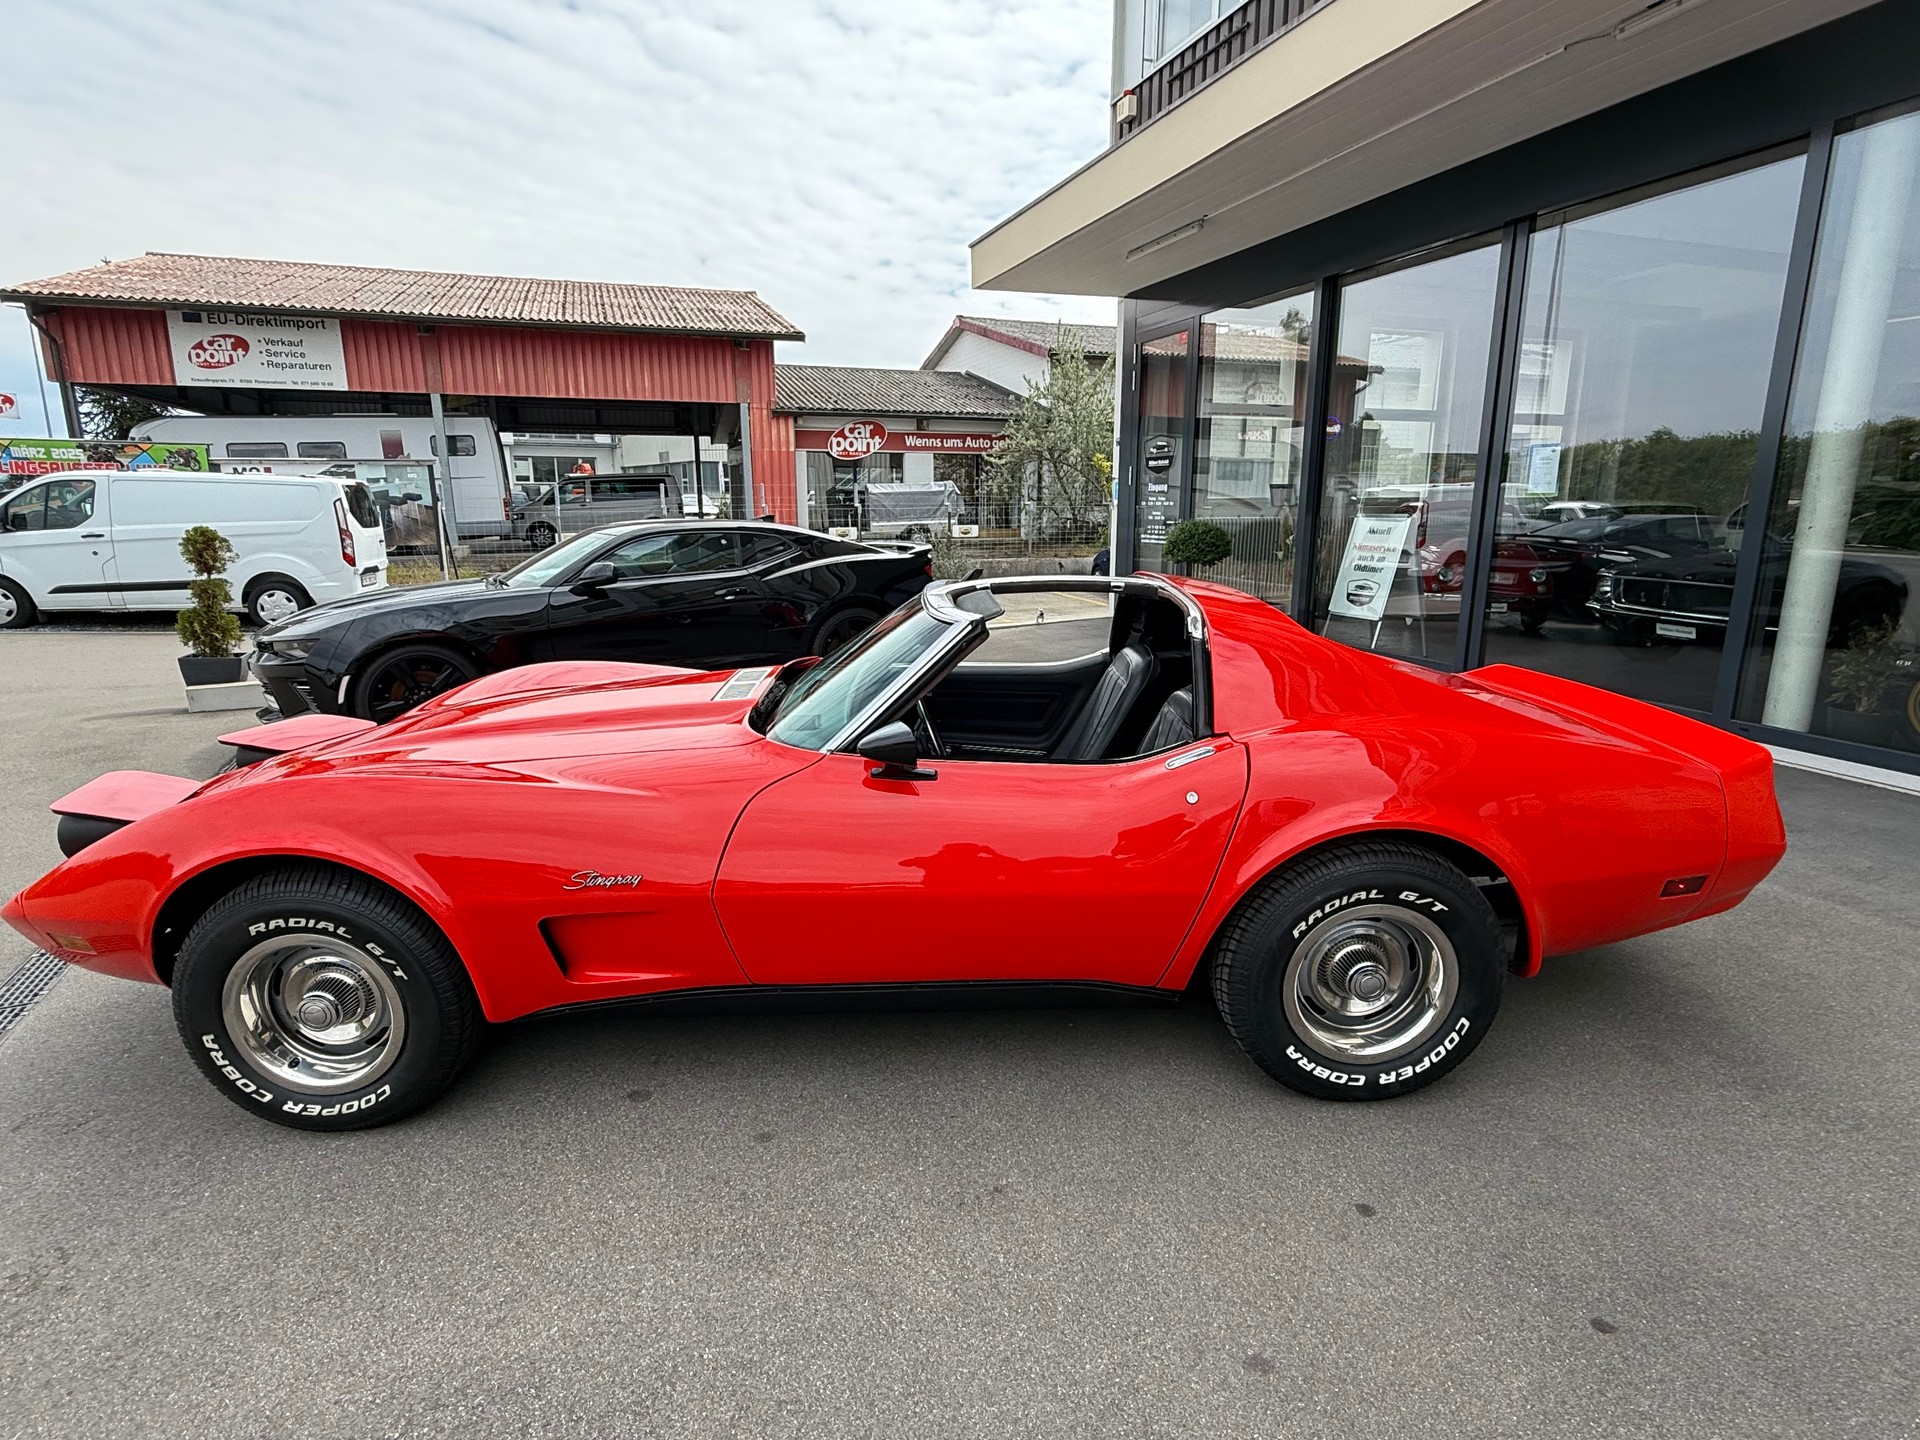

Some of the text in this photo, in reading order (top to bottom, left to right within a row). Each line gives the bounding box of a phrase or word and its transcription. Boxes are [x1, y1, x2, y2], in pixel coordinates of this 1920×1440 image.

[207, 313, 327, 331] EU-Direktimport
[202, 337, 234, 350] car
[263, 337, 304, 348] Verkauf
[190, 348, 246, 364] point
[265, 348, 306, 359] Service
[266, 360, 332, 371] Reparaturen
[843, 423, 874, 438] car
[832, 435, 882, 454] point
[905, 435, 942, 447] Wenns
[964, 437, 991, 448] Auto
[10, 445, 85, 460] MÄRZ 2025
[1367, 526, 1393, 535] Aktuell
[1357, 554, 1375, 562] auch
[1353, 564, 1384, 573] Oldtimer
[562, 870, 643, 890] Stingray
[1292, 889, 1449, 939] RADIAL G/T
[249, 918, 408, 981] RADIAL G/T
[1285, 1016, 1470, 1086] COOPER COBRA
[202, 1033, 391, 1116] COOPER COBRA
